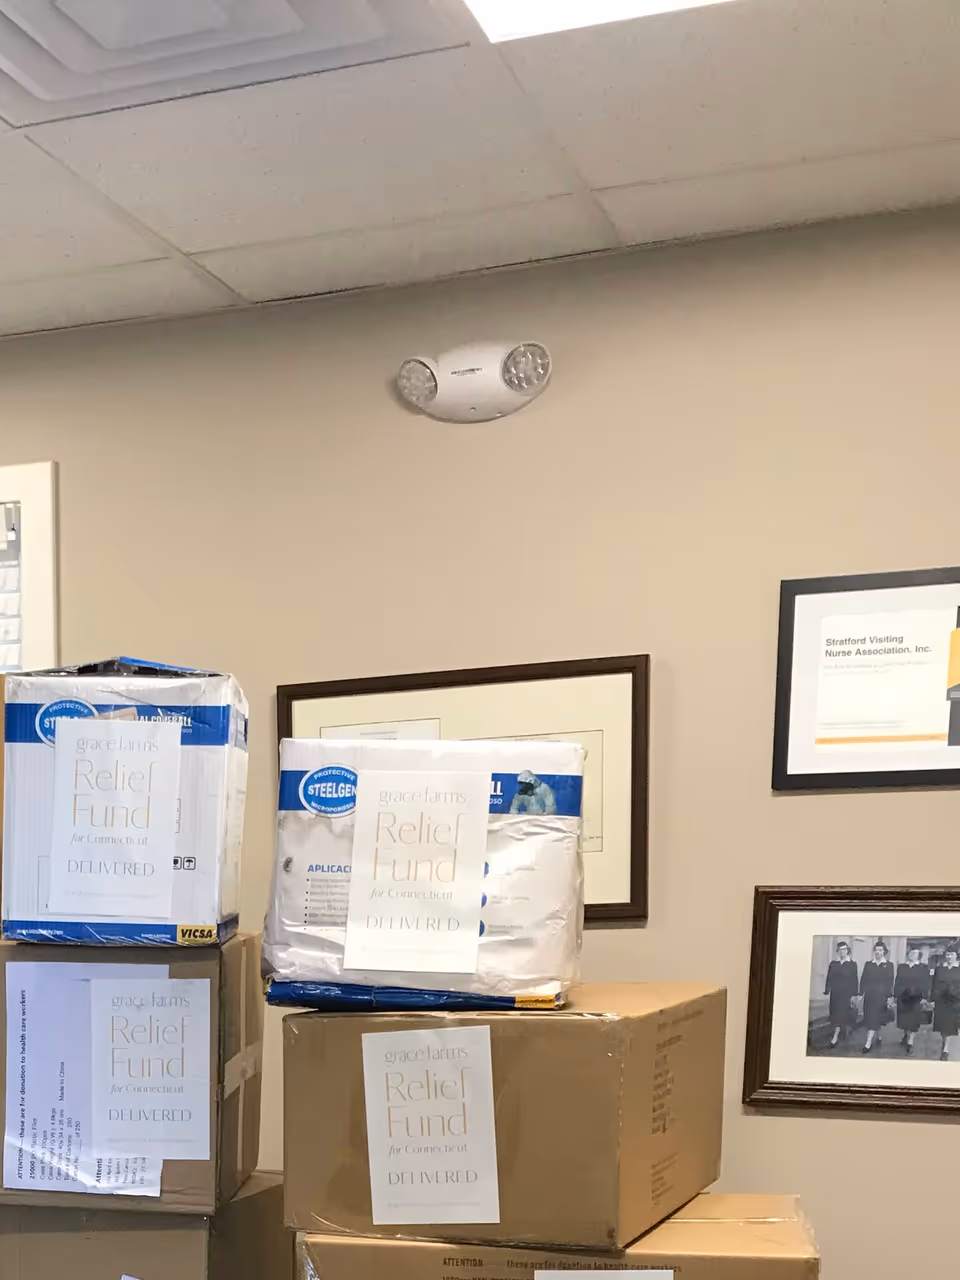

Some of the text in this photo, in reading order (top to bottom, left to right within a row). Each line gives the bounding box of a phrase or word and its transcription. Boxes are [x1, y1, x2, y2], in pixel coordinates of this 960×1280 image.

[825, 635, 904, 647] Stratford Visiting
[825, 649, 852, 658] Nurse
[915, 645, 932, 653] Inc.
[76, 736, 116, 754] grace
[74, 759, 164, 792] Relief
[314, 769, 355, 780] PROTECTIVE
[379, 789, 422, 807] grace
[72, 794, 151, 828] Fund
[376, 812, 466, 845] Relief
[67, 859, 155, 877] DELIVERED
[373, 847, 457, 882] Fund
[366, 914, 460, 932] DELIVERED
[180, 928, 213, 939] VICSA
[111, 995, 145, 1010] grace
[111, 1015, 193, 1044] Relief
[19, 1056, 26, 1064] to
[111, 1047, 185, 1078] Fund
[384, 1049, 425, 1064] grace
[385, 1066, 473, 1103] Relief
[109, 1109, 192, 1122] DELIVERED
[388, 1102, 467, 1138] Fund
[388, 1169, 478, 1185] DELIVERED
[443, 1258, 483, 1267] ATTENTION
